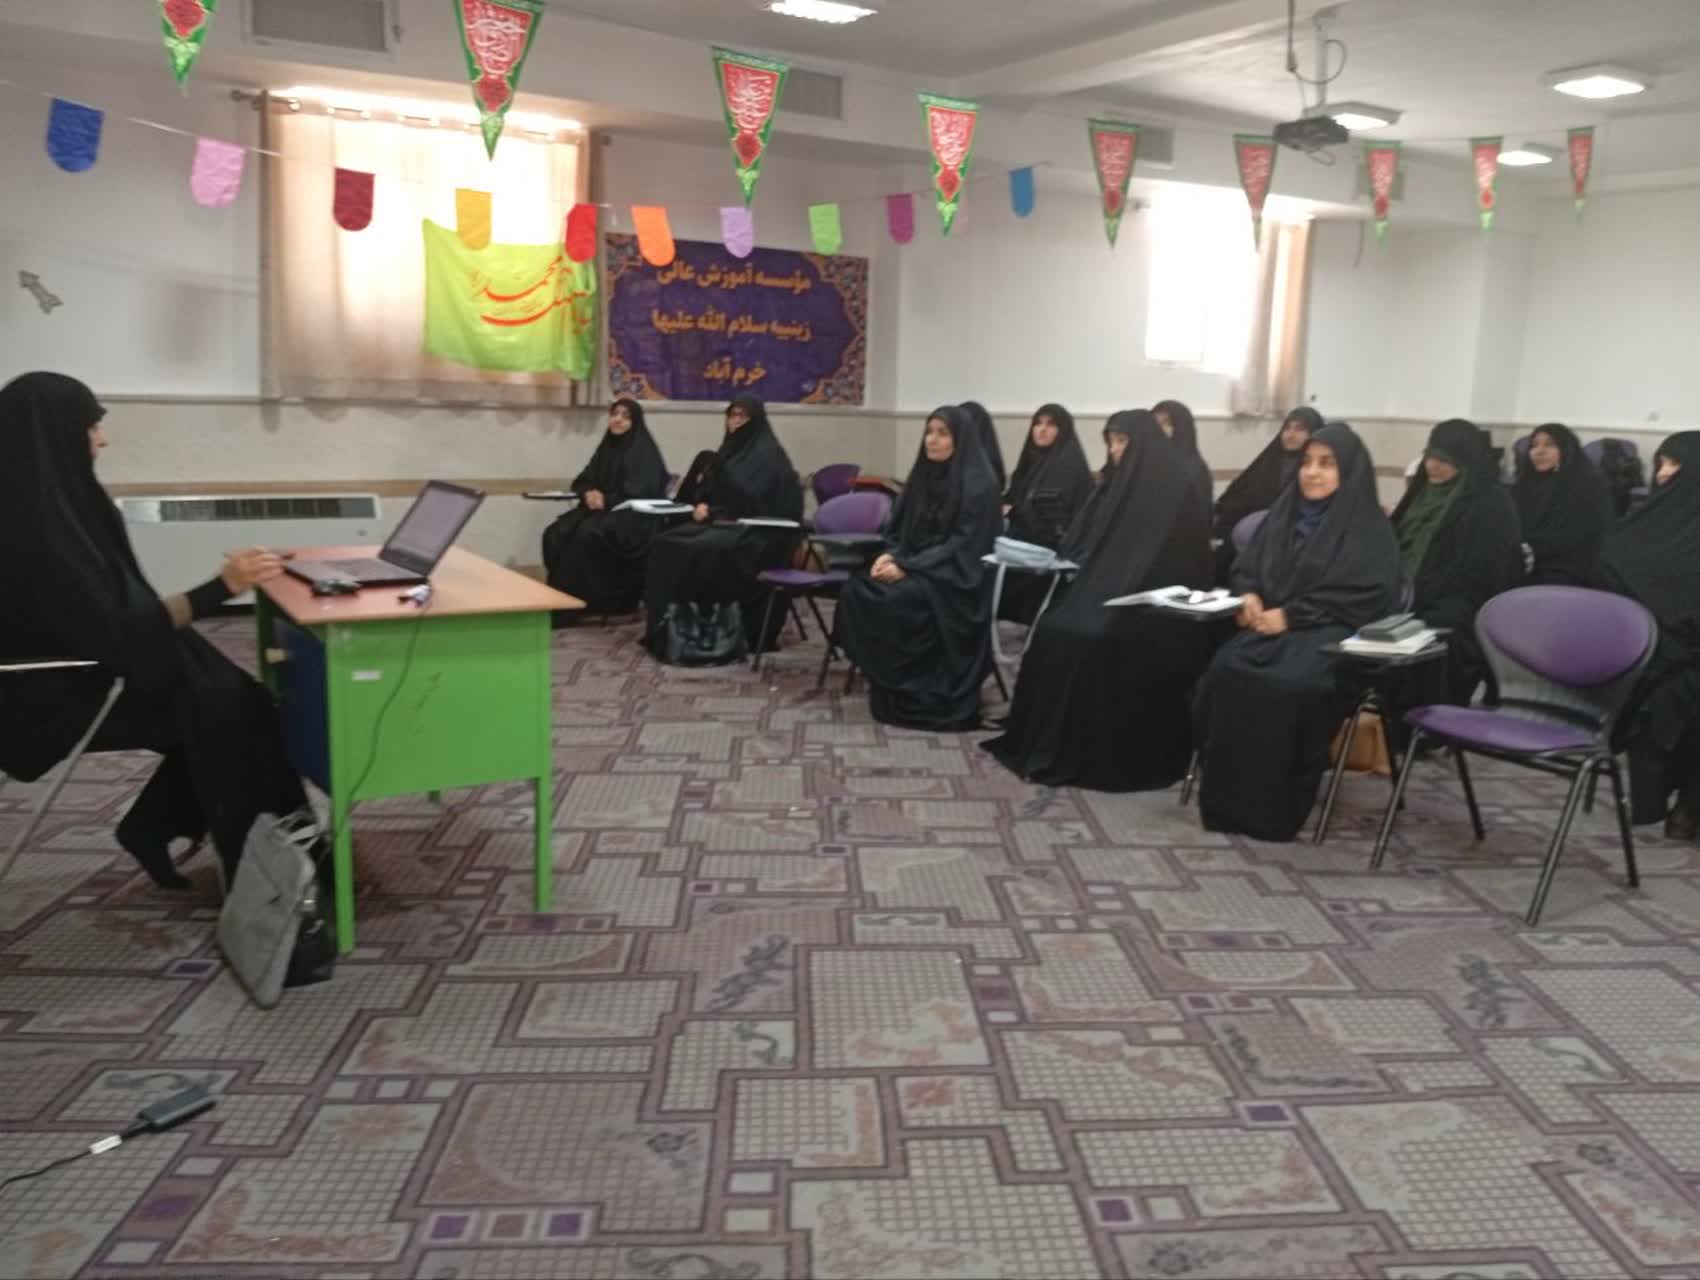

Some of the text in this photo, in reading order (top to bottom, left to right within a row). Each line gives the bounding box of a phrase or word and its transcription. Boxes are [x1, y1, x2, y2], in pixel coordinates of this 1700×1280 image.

[656, 260, 695, 285] عالی
[696, 261, 754, 289] آموزش
[651, 307, 697, 335] علیها
[697, 304, 727, 331] الله
[727, 312, 769, 339] سلام
[703, 355, 768, 388] خرم آباد
